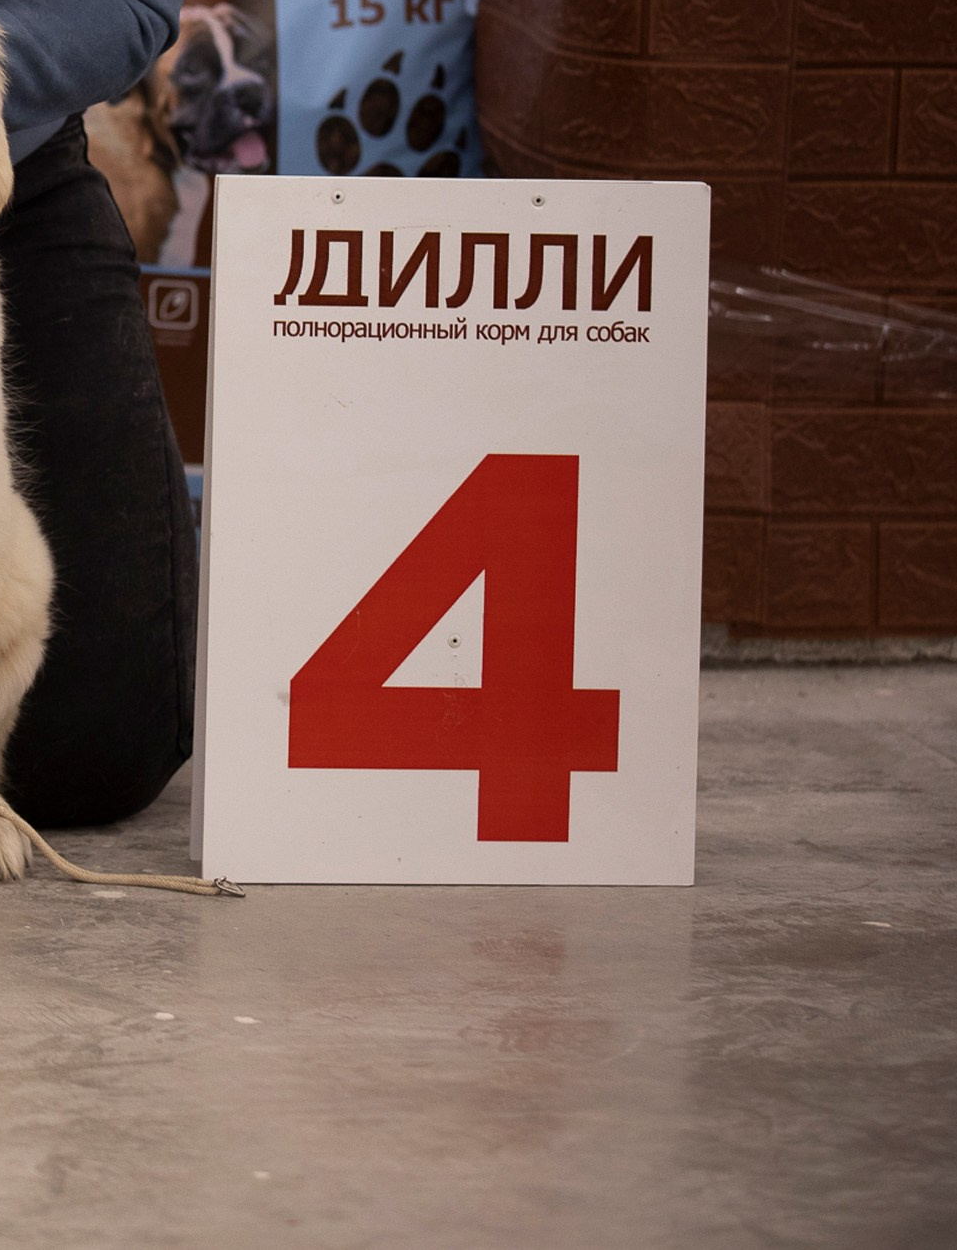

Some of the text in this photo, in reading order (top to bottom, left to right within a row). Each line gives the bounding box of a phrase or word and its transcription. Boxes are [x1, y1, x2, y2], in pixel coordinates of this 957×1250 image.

[274, 229, 653, 312] ДИЛЛИ
[273, 317, 650, 345] полнорационный корм для собак
[288, 454, 621, 842] 4
